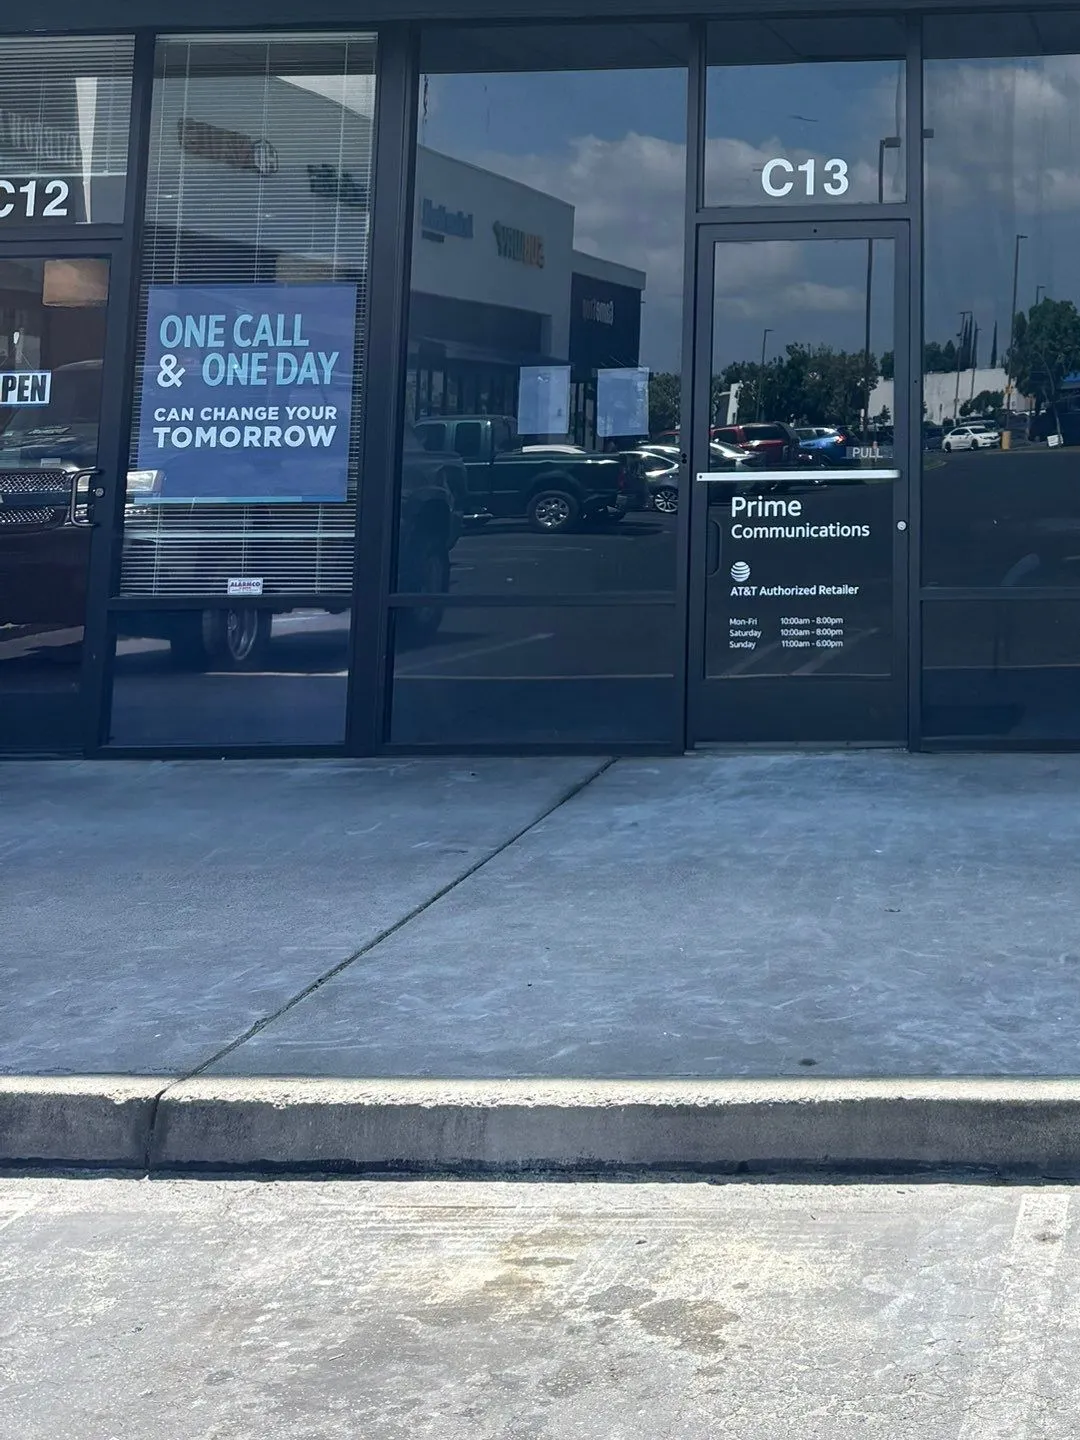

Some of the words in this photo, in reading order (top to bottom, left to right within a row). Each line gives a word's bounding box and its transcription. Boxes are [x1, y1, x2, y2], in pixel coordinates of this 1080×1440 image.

[761, 158, 849, 197] C13
[159, 314, 226, 348] ONE
[233, 313, 309, 347] CALL
[157, 354, 185, 388] &
[202, 352, 268, 386] ONE
[276, 351, 339, 385] DAY
[1, 375, 47, 402] PEN
[154, 407, 194, 421] CAN
[200, 407, 279, 421] CHANGE
[285, 406, 337, 420] YOUR
[153, 425, 337, 448] TOMORROW
[852, 447, 883, 459] PULL
[731, 495, 802, 517] Prime
[731, 522, 870, 539] Communications
[730, 586, 757, 596] AT&T
[760, 585, 816, 596] Authorized
[819, 584, 859, 595] Retailer
[780, 617, 810, 625] 10:00am
[816, 617, 843, 626] 8:00pm
[729, 629, 761, 638] Saturday
[816, 628, 843, 637] 8:00pm
[729, 641, 756, 650] Sunday
